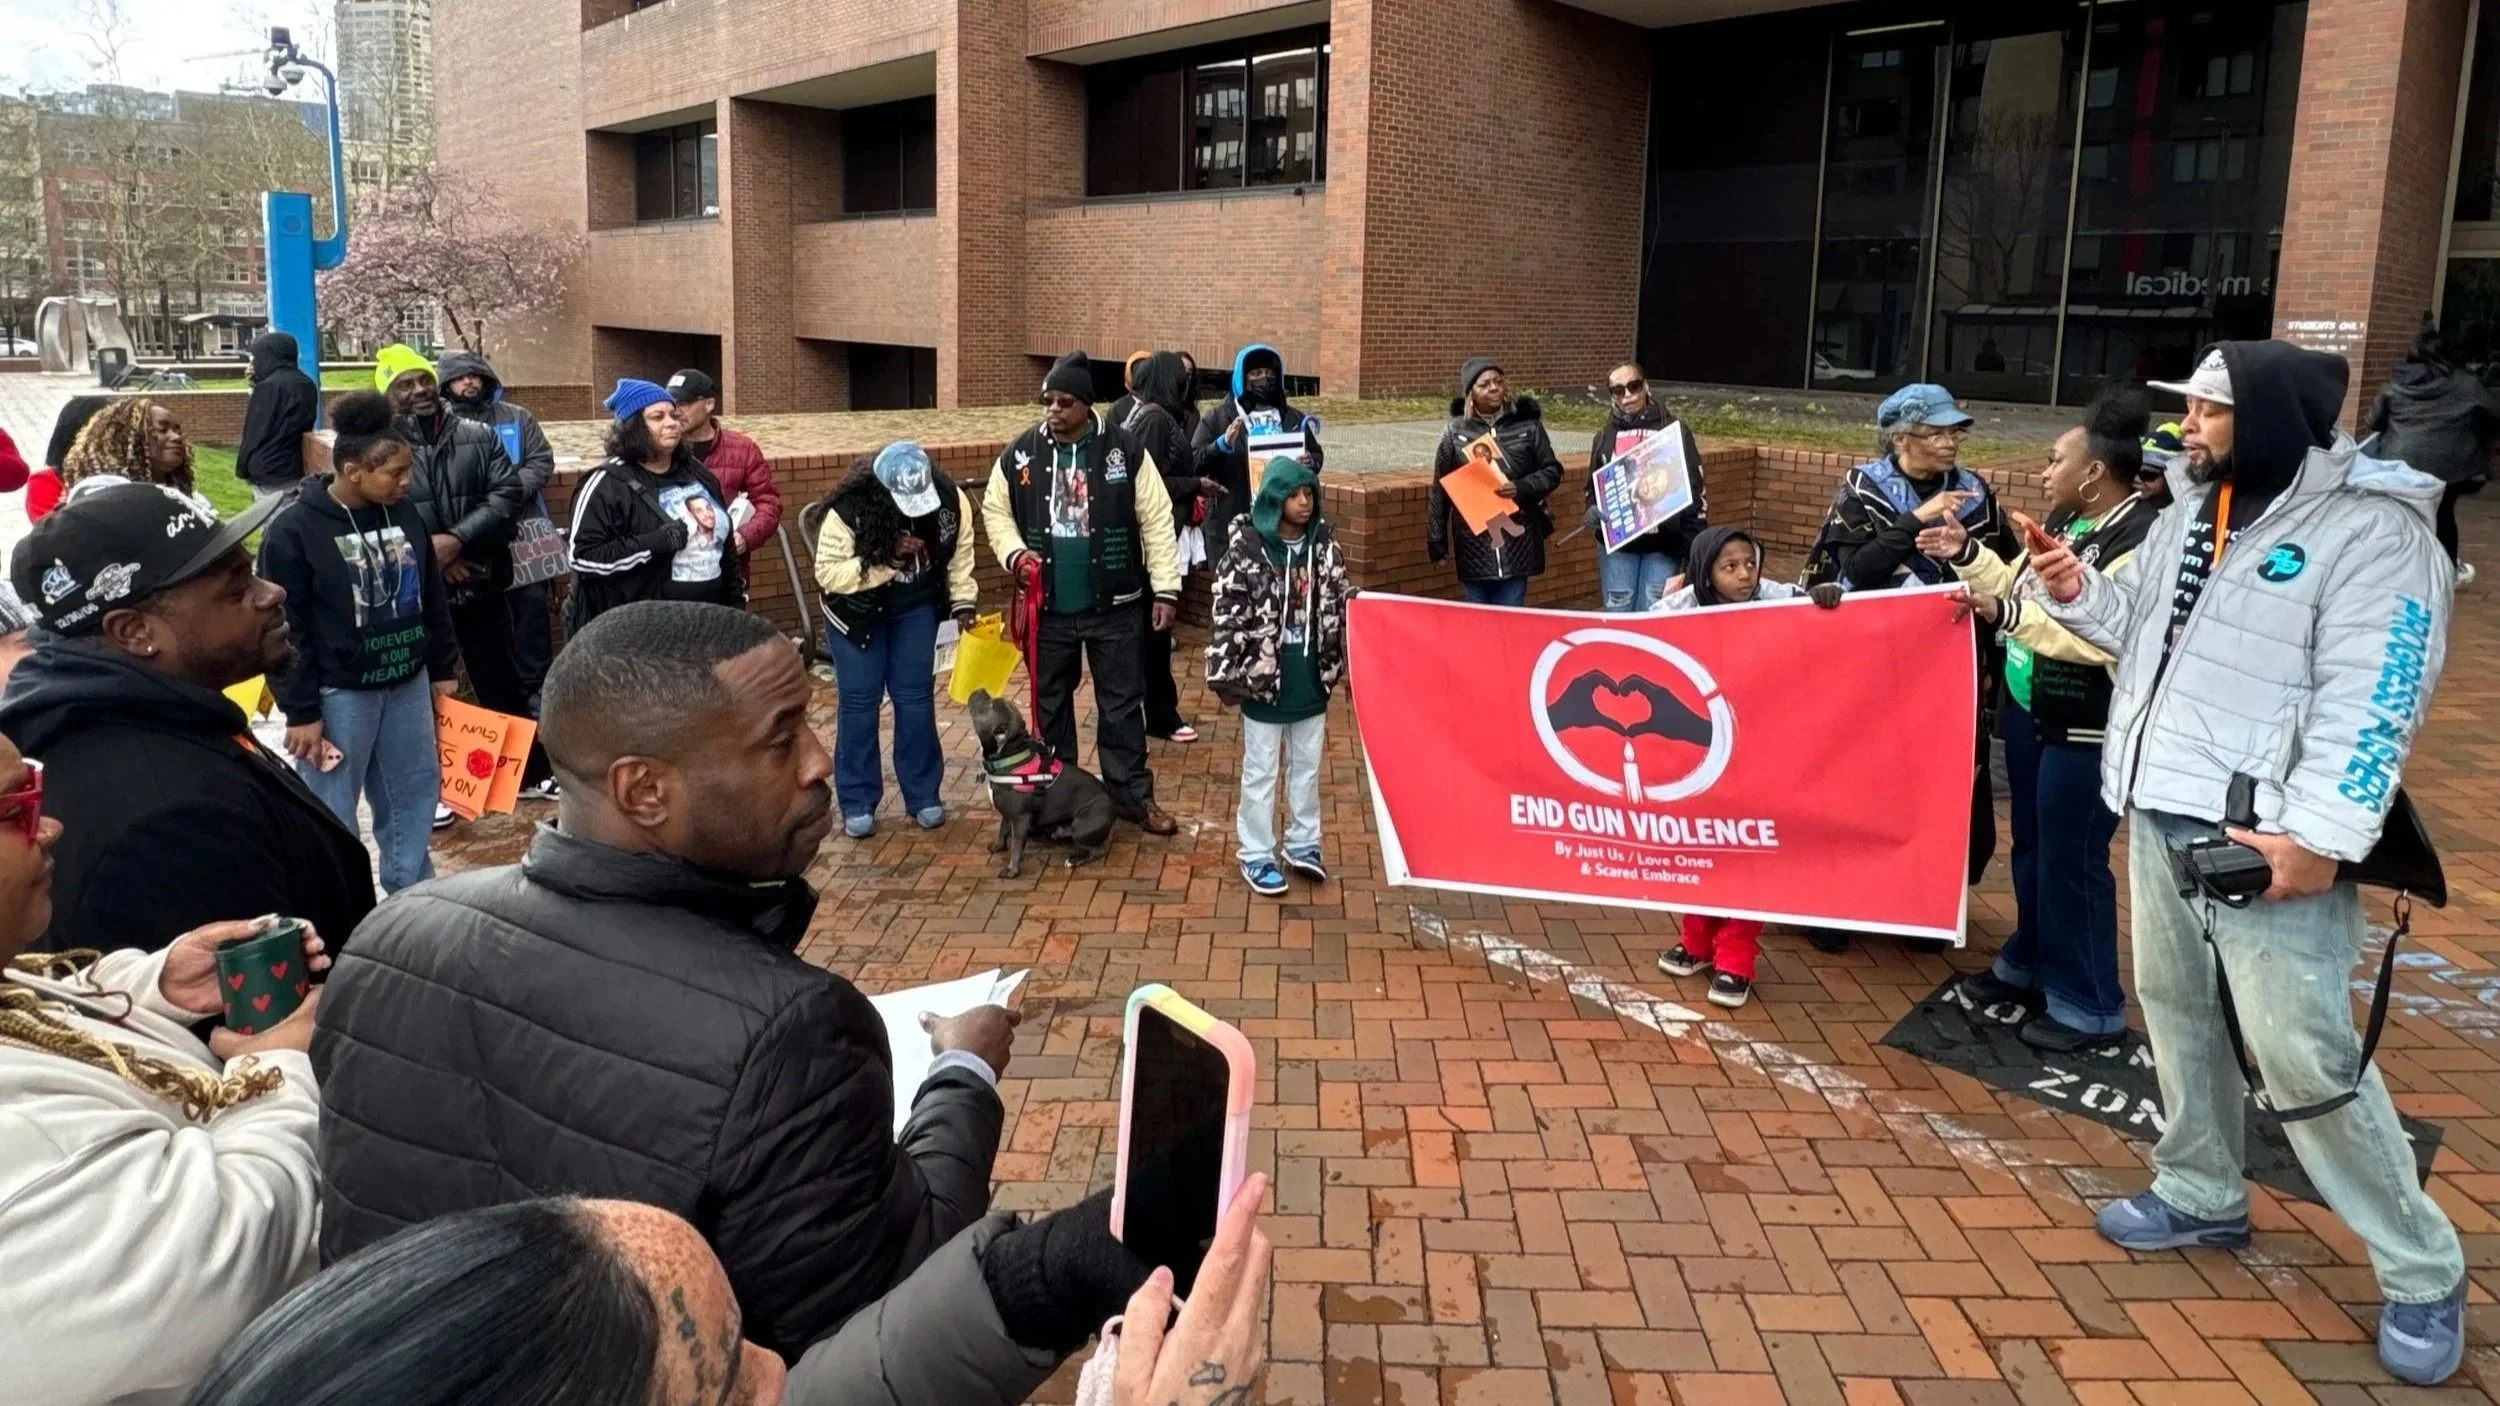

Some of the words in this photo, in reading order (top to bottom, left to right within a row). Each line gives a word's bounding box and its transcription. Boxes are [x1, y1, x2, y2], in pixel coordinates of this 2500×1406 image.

[361, 658, 421, 684] HEART
[390, 647, 410, 663] OUR
[2371, 593, 2432, 721] PROGRESS
[2337, 710, 2405, 814] PUSHERS
[1510, 794, 1564, 828] END
[1568, 802, 1626, 837] GUN
[1628, 810, 1779, 846] VIOLENCE
[1555, 841, 1571, 858] By
[1576, 843, 1603, 859] Just
[1607, 847, 1625, 862] Us
[1637, 853, 1671, 868] Love
[1675, 854, 1714, 869] Ones
[1580, 864, 1591, 875] &
[1594, 863, 1638, 880] Scared
[1642, 868, 1700, 885] Embrace
[2028, 1065, 2169, 1134] ZON
